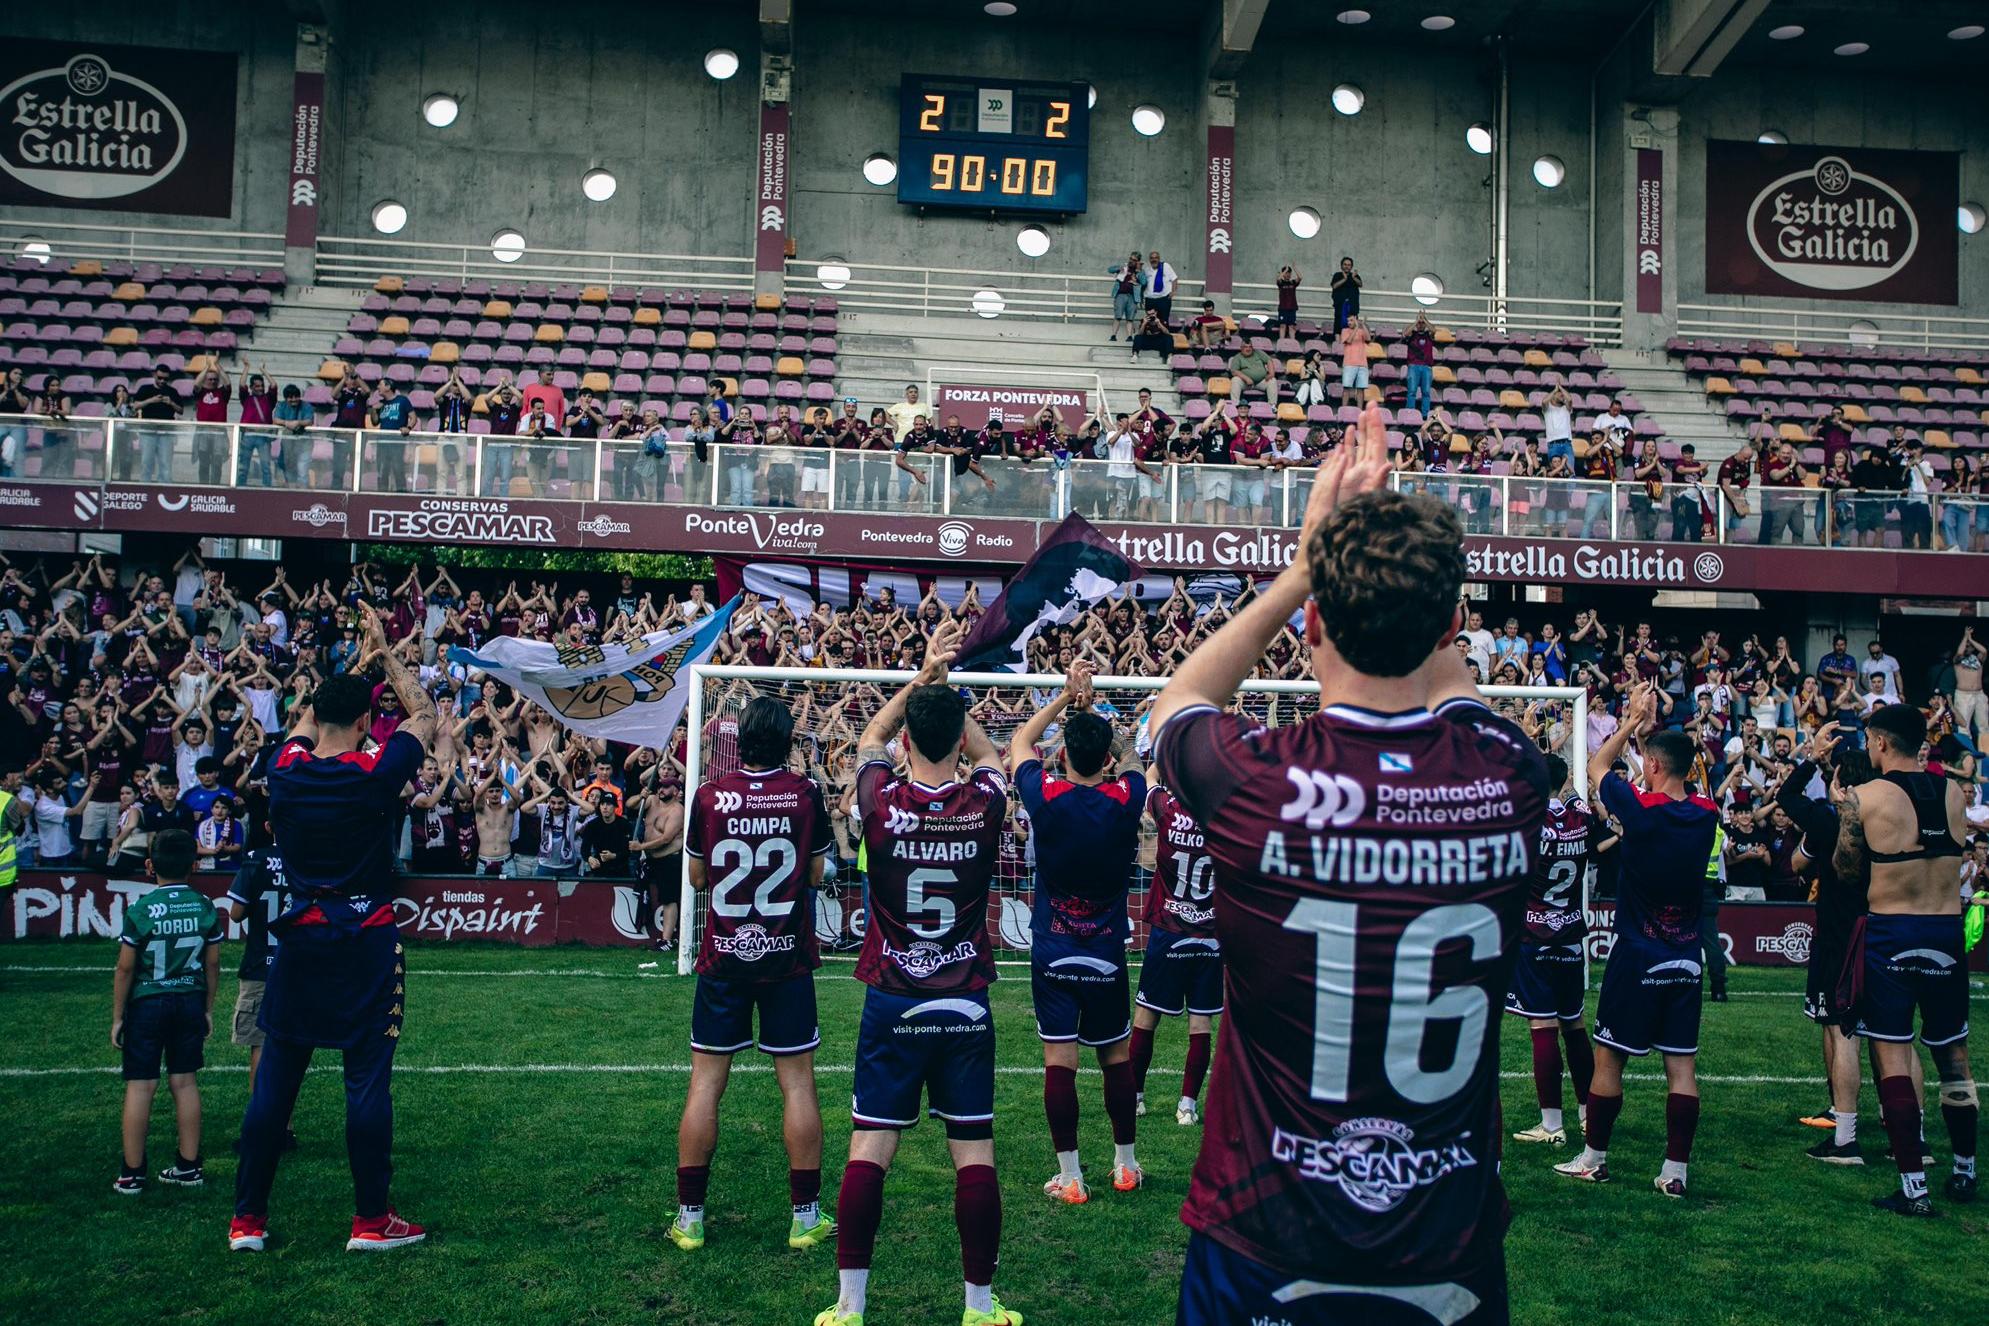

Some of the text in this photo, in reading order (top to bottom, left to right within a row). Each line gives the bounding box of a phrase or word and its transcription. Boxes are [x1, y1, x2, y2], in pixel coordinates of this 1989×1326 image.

[12, 92, 162, 136] Estrella
[920, 95, 1070, 138] 2 2
[18, 127, 153, 170] Galicia
[293, 104, 308, 174] Deputación
[305, 105, 320, 175] Pontevedra
[762, 132, 774, 200] Deputación
[773, 133, 785, 200] Pontevedra
[1210, 157, 1220, 223] Deputación
[1220, 157, 1231, 223] Pontevedra
[1639, 180, 1650, 245] Deputación
[1650, 180, 1660, 246] Pontevedra
[1771, 192, 1896, 229] Estrella
[1778, 225, 1890, 262] Galicia
[945, 389, 1081, 406] FORZA PONTEVEDRA
[0, 488, 31, 497] ALICIA
[0, 496, 41, 506] AUDABLE
[103, 501, 143, 511] GALEGO
[104, 491, 148, 502] DEPORTE
[191, 495, 226, 505] GALICIA
[420, 499, 508, 513] CONSERVAS
[191, 503, 236, 513] SAUDABLE
[292, 509, 347, 523] PESCAMAR
[368, 508, 556, 543] PESCAMAR
[577, 520, 631, 534] PESCAMAR
[861, 529, 934, 544] Pontevedra
[976, 534, 1013, 547] Radio
[1106, 530, 1302, 568] trella Galic
[1462, 544, 1685, 582] strella Galicia
[746, 792, 798, 802] Deputación
[746, 800, 798, 810] Pontevedra
[1377, 777, 1509, 807] Deputación
[727, 817, 792, 835] COMPA
[924, 819, 985, 831] Pontevedra
[925, 811, 984, 824] Deputación
[1377, 799, 1513, 824] Pontevedra
[892, 840, 978, 861] ALVARO
[1168, 829, 1204, 847] VELKO
[1540, 840, 1587, 857] V. EIMIL
[1260, 830, 1528, 885] A. VIDORRETA
[711, 838, 797, 918] 22
[1171, 851, 1216, 900] 10
[1543, 860, 1577, 907] 2
[443, 890, 485, 903] tiendas
[906, 867, 959, 939] 5
[152, 917, 199, 936] JORDI
[392, 890, 545, 940] Dispaint
[146, 935, 204, 980] 17
[1756, 936, 1811, 952] PESCA
[1282, 897, 1502, 1104] 16
[893, 1023, 987, 1035] visit-ponte vedra.com
